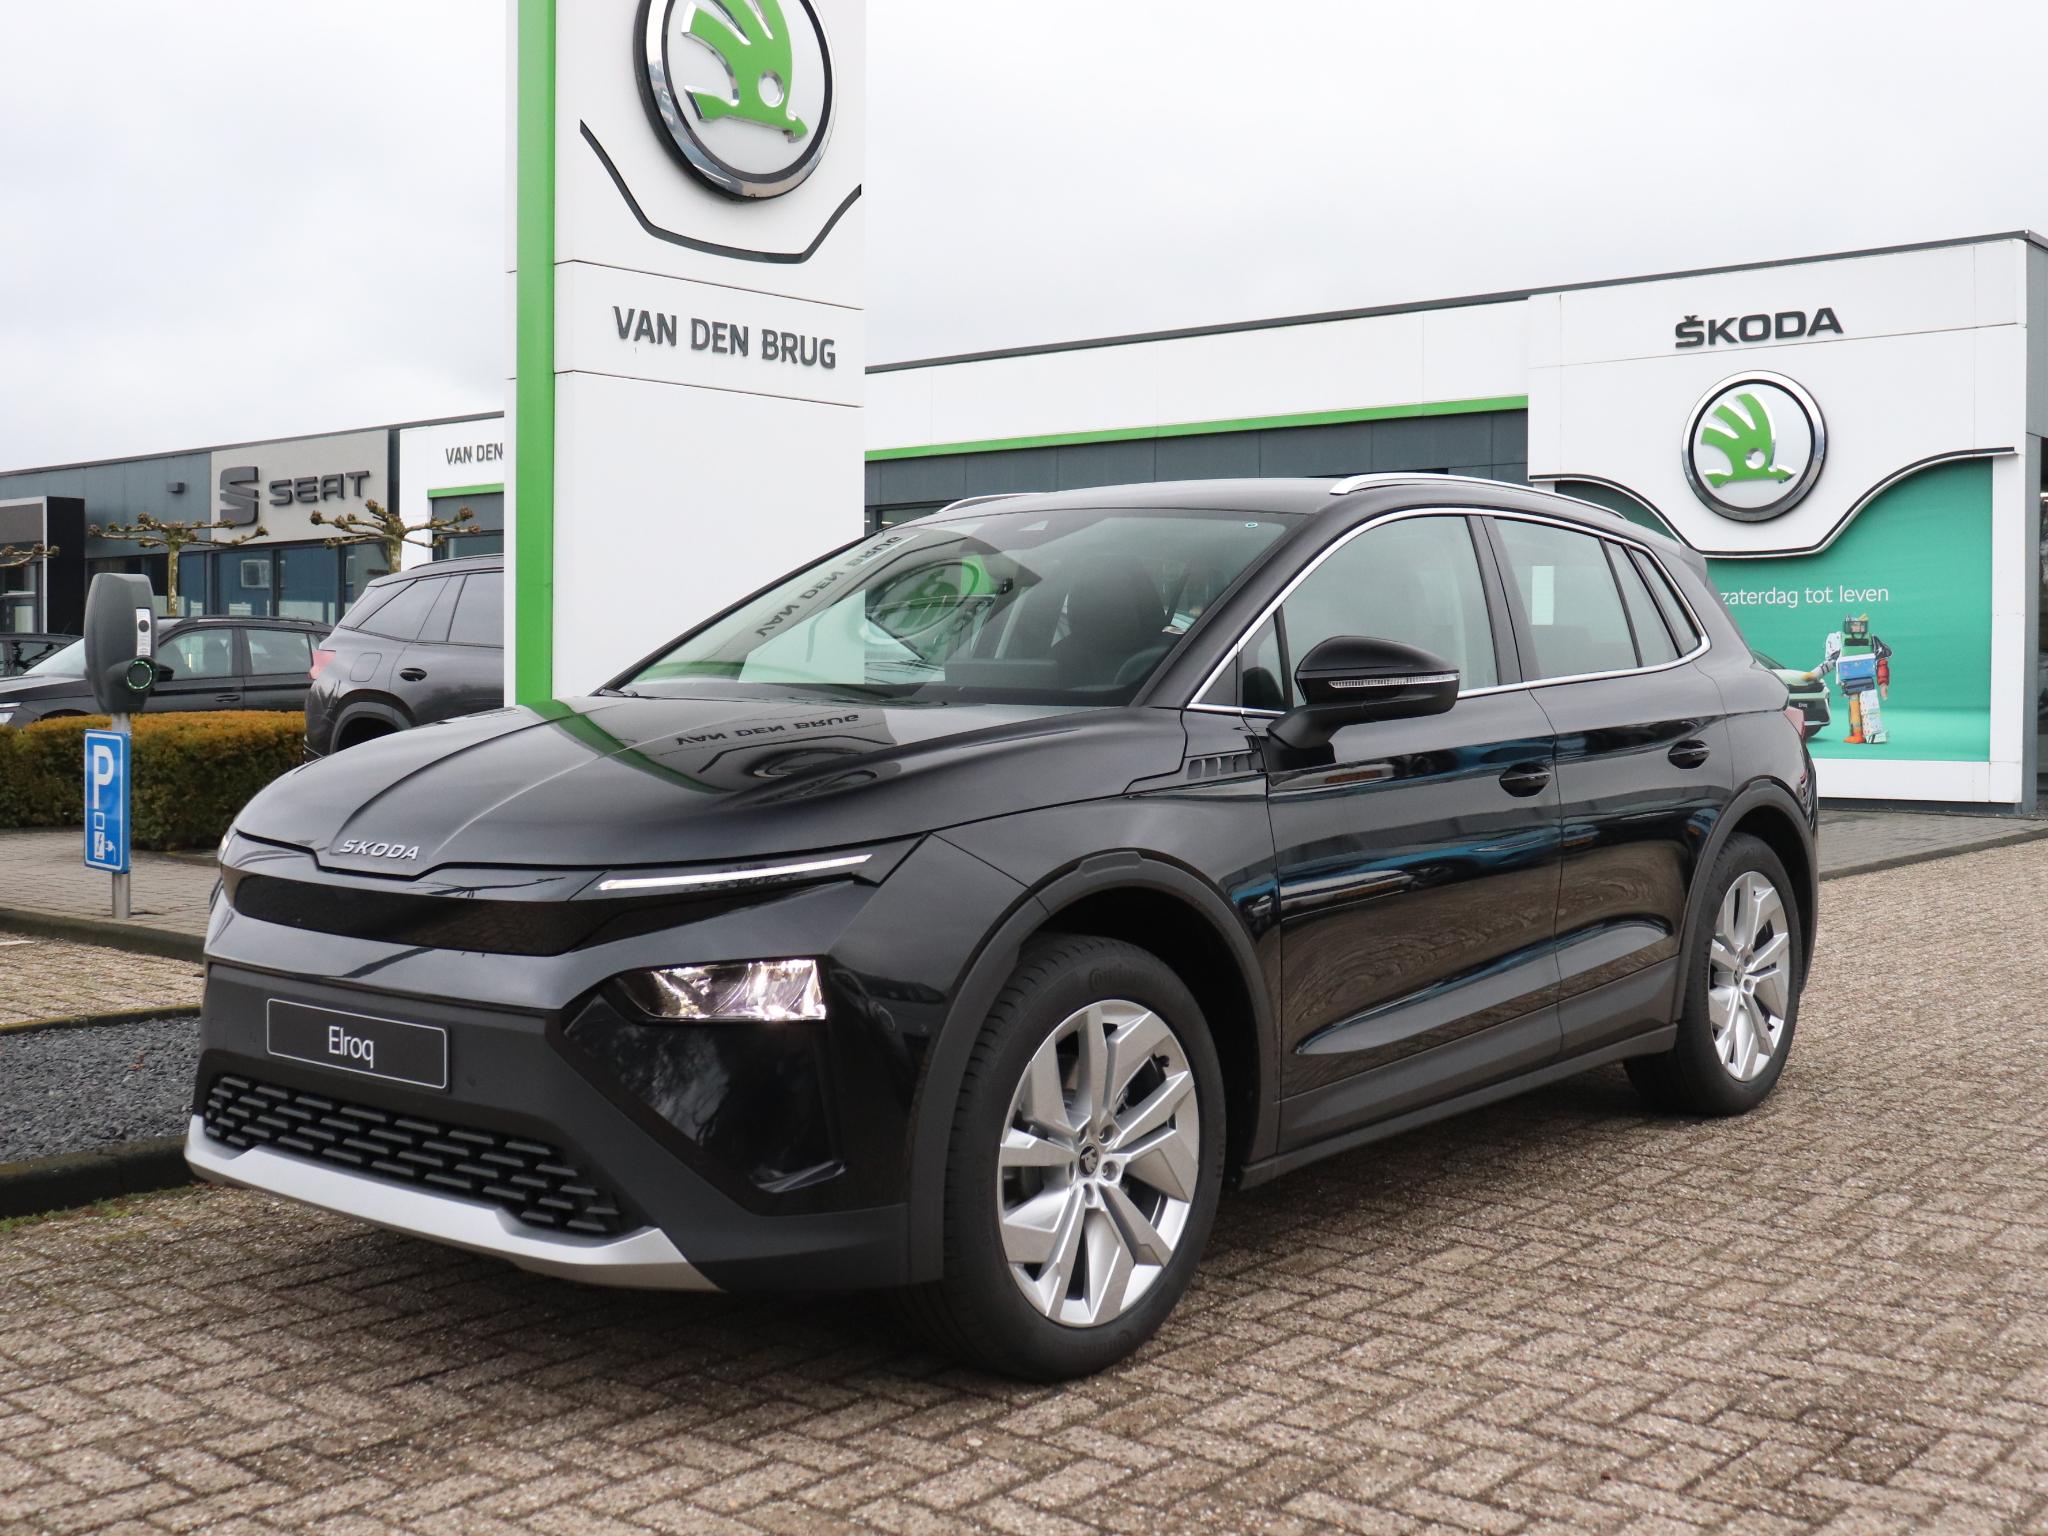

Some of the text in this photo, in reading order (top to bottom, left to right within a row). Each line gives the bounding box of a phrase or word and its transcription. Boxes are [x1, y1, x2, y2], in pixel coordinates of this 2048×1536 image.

[613, 306, 836, 369] VAN DEN BRUG
[1675, 307, 1844, 349] ŠKODA
[445, 442, 504, 465] VAN DEN
[269, 470, 371, 506] SEAT
[1721, 585, 1889, 609] zaterdag tot leven
[93, 745, 115, 810] P
[328, 1025, 374, 1069] Elroq
